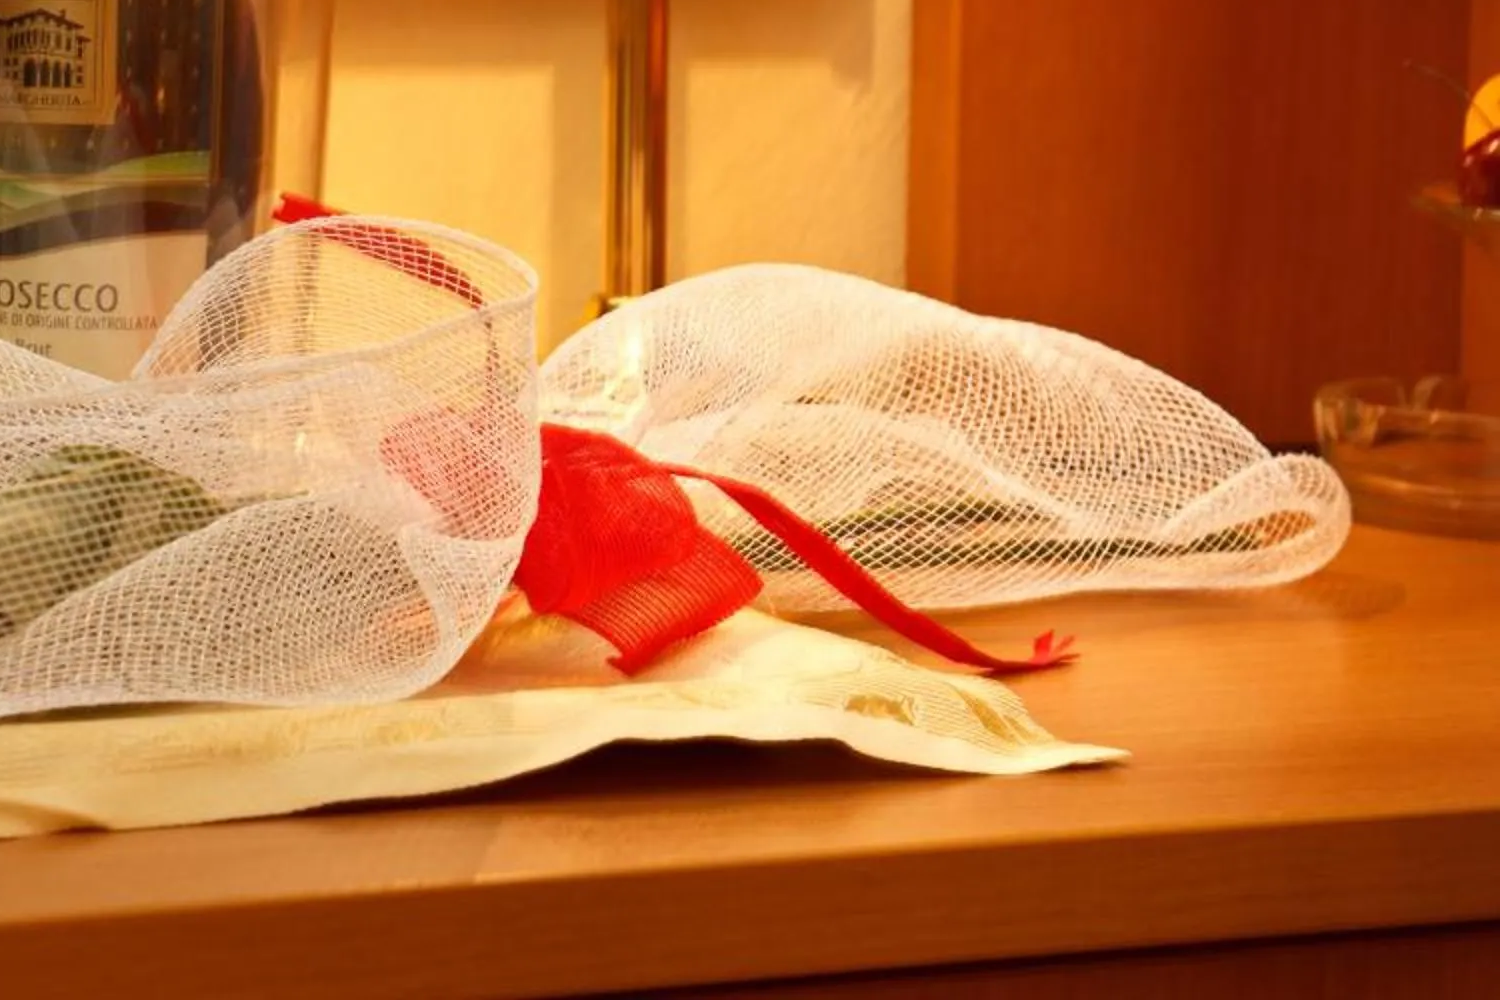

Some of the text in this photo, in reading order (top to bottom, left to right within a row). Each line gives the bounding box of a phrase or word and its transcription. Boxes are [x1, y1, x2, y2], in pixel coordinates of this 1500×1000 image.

[11, 313, 23, 327] DI
[25, 314, 71, 330] ORIGINE
[74, 316, 157, 331] CONTROLLATA
